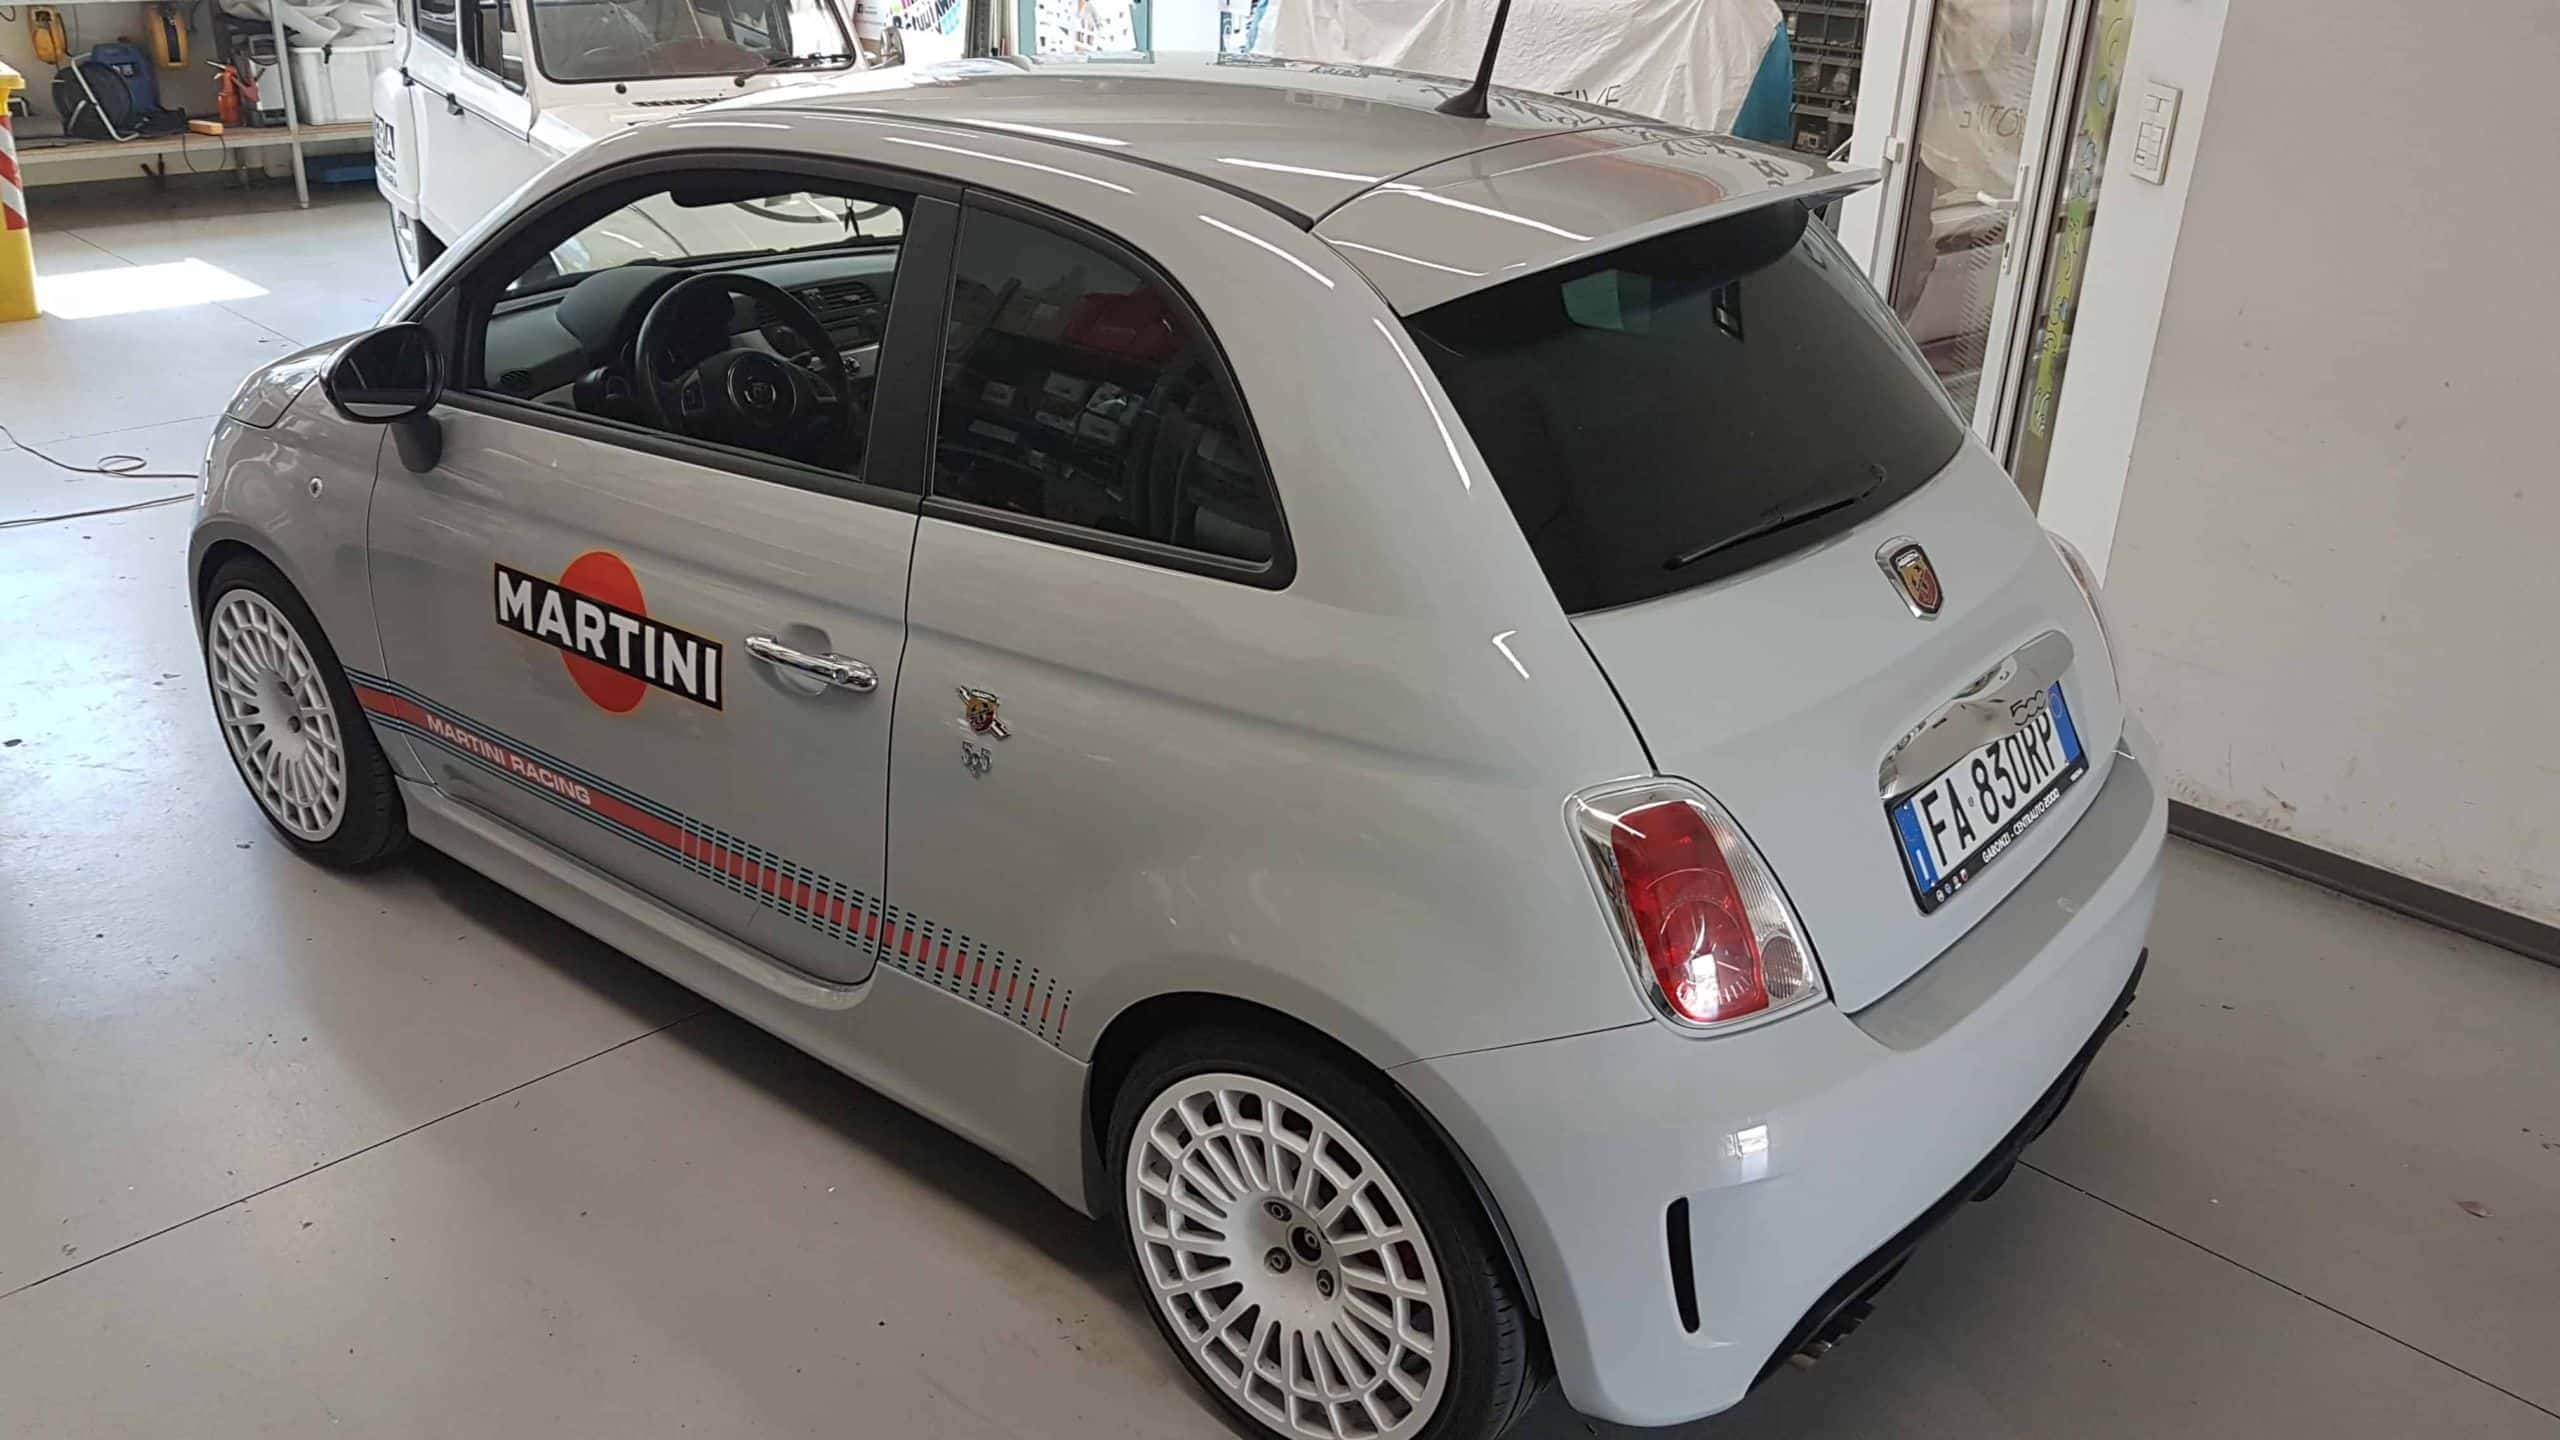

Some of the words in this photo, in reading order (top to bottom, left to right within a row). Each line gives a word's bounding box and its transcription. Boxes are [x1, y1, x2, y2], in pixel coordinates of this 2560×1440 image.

[499, 571, 717, 703] MARTINI
[426, 715, 505, 765] MARTINI
[511, 754, 591, 805] RACING
